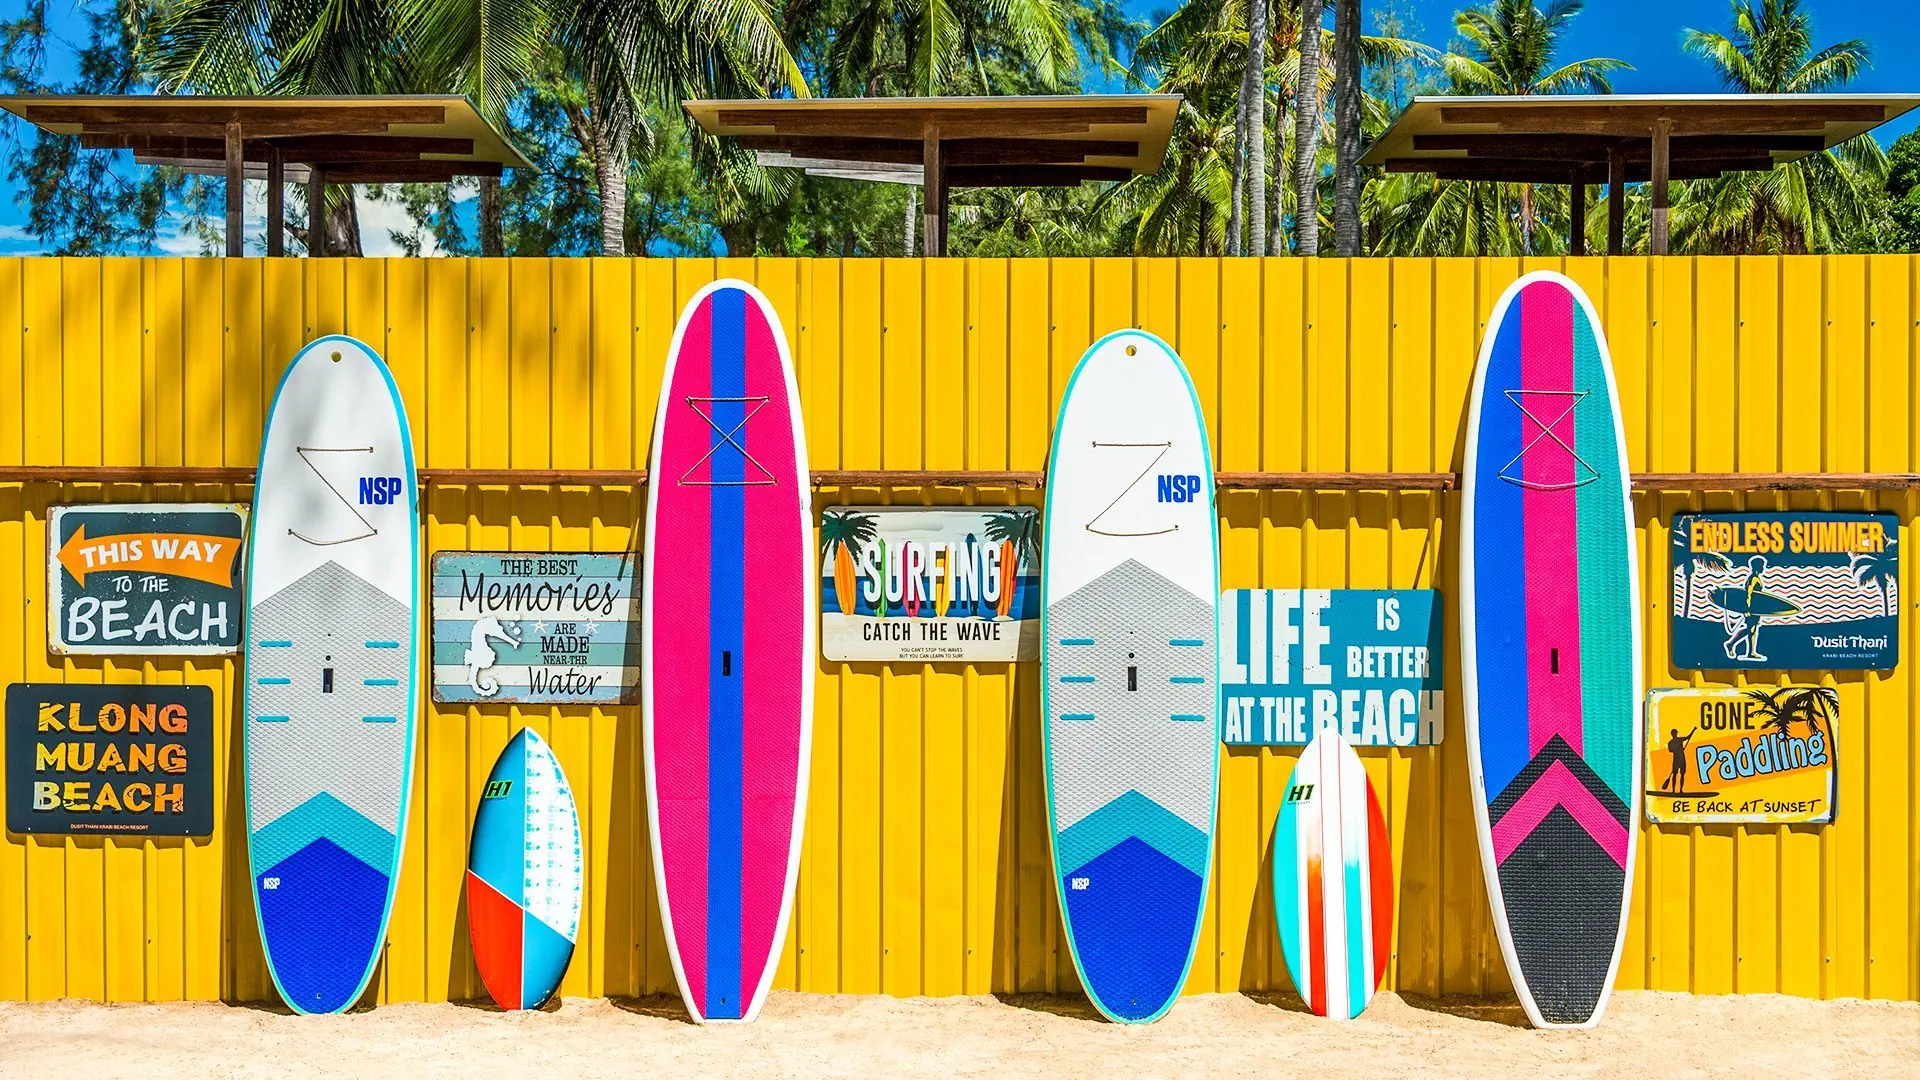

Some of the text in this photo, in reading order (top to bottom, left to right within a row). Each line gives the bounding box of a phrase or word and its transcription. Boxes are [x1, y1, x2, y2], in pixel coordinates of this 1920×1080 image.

[359, 477, 402, 505] NSP
[1157, 475, 1201, 503] NSP
[1690, 521, 1884, 553] ENDLESS SUMMER
[79, 539, 222, 568] THIS WAY
[500, 559, 578, 575] THE BEST
[112, 575, 170, 593] TO THE
[863, 541, 1001, 604] SURFING
[459, 569, 620, 615] Memories
[68, 596, 228, 642] BEACH
[554, 622, 577, 635] ARE
[863, 622, 1001, 641] CATCH THE WAVE
[540, 635, 590, 654] MADE
[1221, 589, 1400, 684] LIFE IS
[1811, 635, 1888, 650] Dusit Thani
[543, 654, 568, 665] NEAR
[1347, 646, 1430, 678] BETTER
[528, 666, 602, 695] Water
[38, 702, 188, 733] KLONG
[1225, 689, 1444, 746] AT THE BEACH
[1700, 702, 1755, 730] GONE
[35, 742, 188, 774] MUANG
[1696, 730, 1827, 784] Paddling
[33, 781, 185, 812] BEACH
[485, 780, 514, 798] H1
[1288, 784, 1315, 801] H1
[1672, 799, 1822, 813] BE BACK AT SUNSET
[263, 877, 281, 889] NSP
[1071, 877, 1090, 890] NSP
